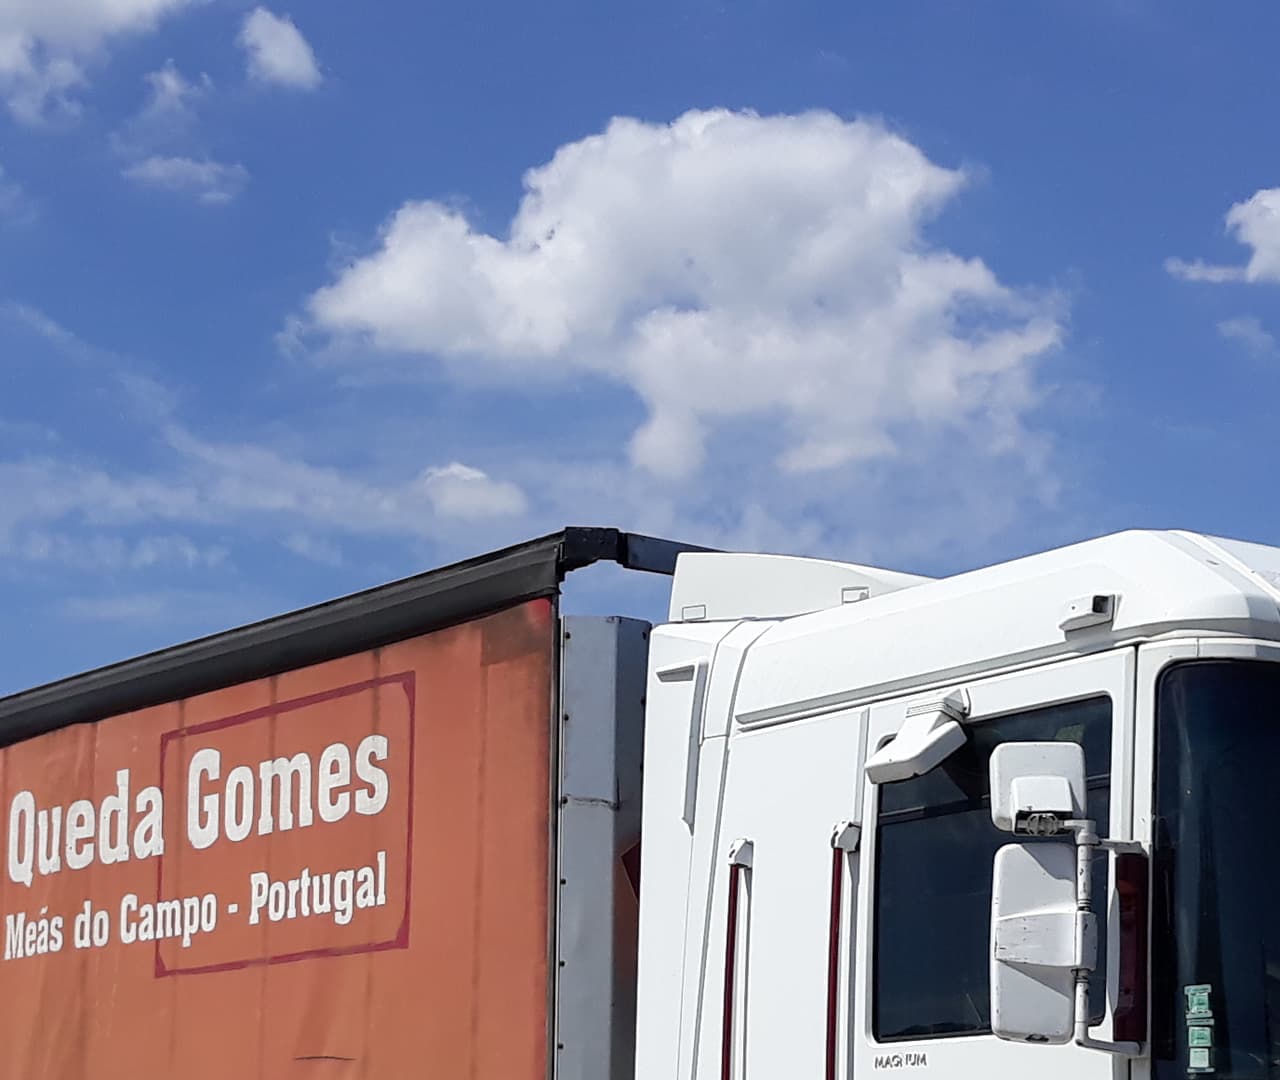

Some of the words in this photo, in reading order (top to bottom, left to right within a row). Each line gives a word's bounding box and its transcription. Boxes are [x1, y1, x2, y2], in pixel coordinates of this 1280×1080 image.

[7, 769, 164, 888] Queda
[187, 734, 389, 849] Gomes
[4, 906, 63, 960] Meás
[74, 900, 110, 949] do
[120, 893, 217, 948] Campo
[249, 851, 386, 925] Portugal
